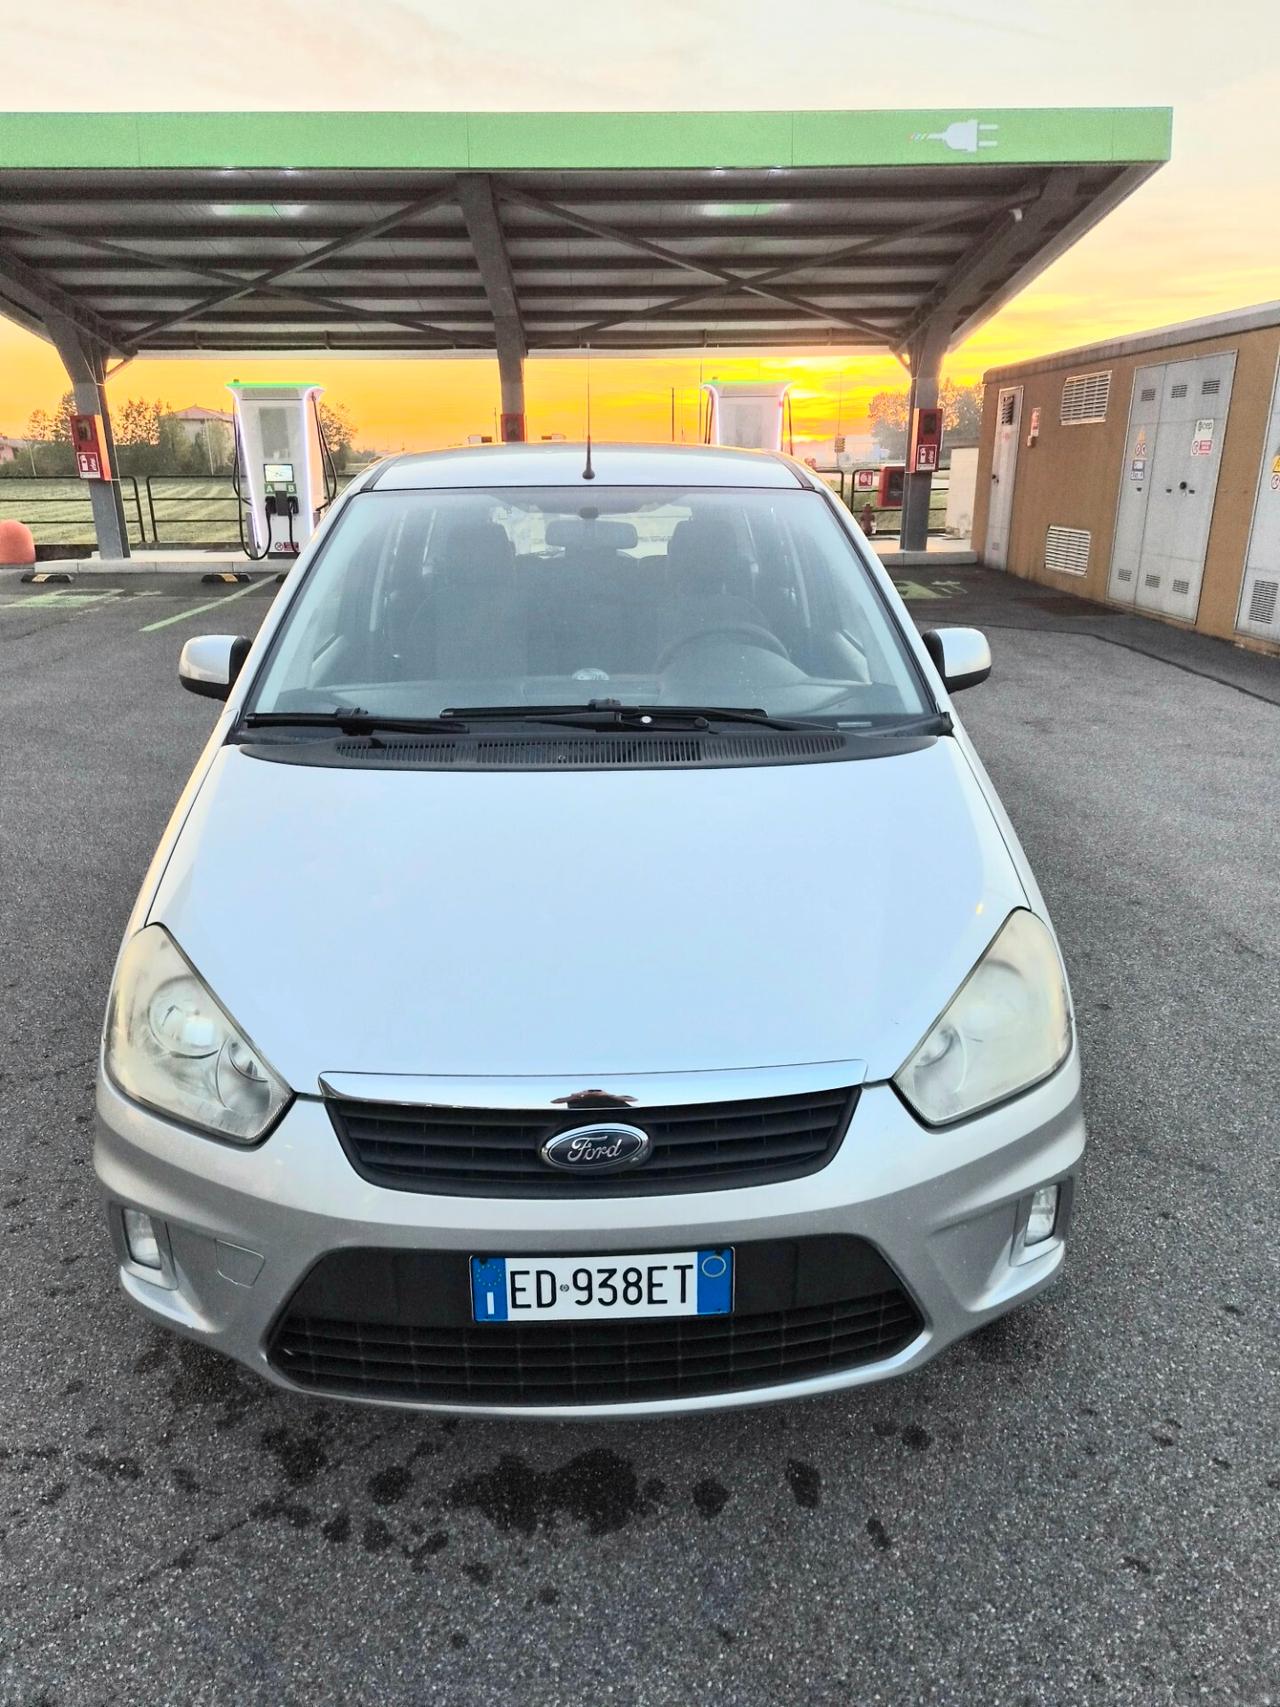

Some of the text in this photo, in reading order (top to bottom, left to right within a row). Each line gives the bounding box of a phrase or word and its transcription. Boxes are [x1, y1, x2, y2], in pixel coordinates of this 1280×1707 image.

[266, 485, 273, 493] A
[288, 485, 295, 493] B
[567, 1135, 623, 1162] Ford
